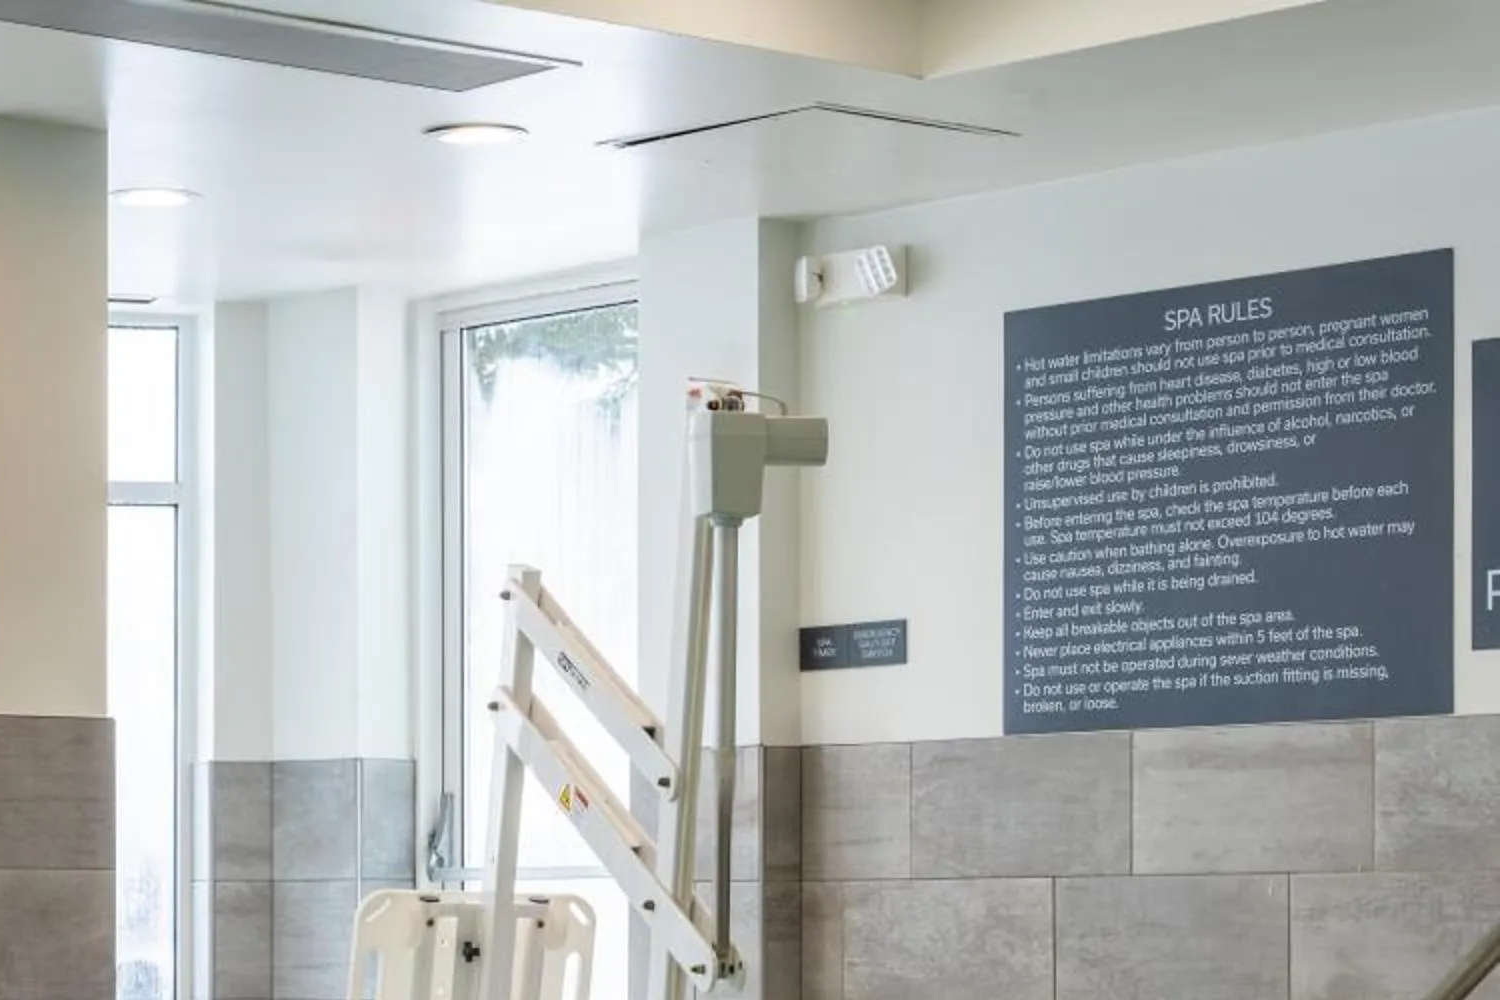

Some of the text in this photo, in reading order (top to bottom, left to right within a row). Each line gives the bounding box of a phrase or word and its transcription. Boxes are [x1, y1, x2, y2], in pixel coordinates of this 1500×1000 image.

[1164, 297, 1272, 330] SPA RULES
[1024, 357, 1044, 372] Hot
[1048, 354, 1079, 369] water
[1146, 343, 1170, 357] vary
[1175, 339, 1202, 352] from
[1253, 329, 1264, 342] to
[1380, 309, 1428, 326] women
[1024, 373, 1045, 388] and
[1048, 369, 1078, 385] small
[1175, 354, 1193, 369] not
[1197, 354, 1219, 366] use
[1223, 351, 1244, 365] spa
[1248, 345, 1275, 363] prior
[1280, 342, 1292, 356] to
[1129, 381, 1156, 394] from
[1159, 374, 1190, 391] heart
[1307, 356, 1333, 374] high
[1337, 357, 1349, 369] or
[1354, 353, 1375, 367] low
[1381, 346, 1418, 363] blood
[1076, 402, 1098, 417] and
[1101, 399, 1132, 414] other
[1281, 378, 1300, 393] not
[1305, 375, 1336, 390] enter
[1341, 371, 1360, 386] the
[1365, 370, 1389, 385] spa
[1226, 401, 1248, 417] and
[1325, 392, 1353, 405] from
[1359, 386, 1386, 402] their
[1024, 446, 1041, 459] Do
[1043, 443, 1062, 457] not
[1065, 443, 1086, 455] use
[1089, 440, 1110, 454] spa
[1113, 434, 1144, 449] while
[1147, 430, 1182, 446] under
[1186, 427, 1205, 441] the
[1267, 418, 1280, 432] of
[1401, 406, 1414, 417] or
[1024, 461, 1053, 475] other
[1057, 459, 1090, 473] drugs
[1093, 453, 1115, 468] that
[1119, 452, 1154, 465] cause
[1303, 434, 1316, 445] or
[1089, 469, 1123, 485] blood
[1107, 491, 1127, 503] use
[1131, 487, 1145, 503] by
[1199, 480, 1208, 493] is
[1115, 507, 1134, 521] the
[1204, 499, 1223, 512] the
[1227, 498, 1248, 513] spa
[1377, 480, 1408, 496] each
[1023, 552, 1045, 565] Use
[1095, 545, 1126, 559] when
[1307, 527, 1319, 541] to
[1323, 524, 1344, 539] hot
[1348, 522, 1382, 537] water
[1387, 521, 1415, 535] may
[1050, 531, 1072, 546] Spa
[1151, 519, 1180, 534] must
[1184, 517, 1204, 531] not
[1255, 510, 1278, 525] 104
[1023, 555, 1190, 582] cause and
[1023, 575, 1204, 601] Do not use spa while it is being
[1023, 606, 1053, 620] Enter
[1056, 603, 1078, 618] and
[1023, 626, 1052, 641] Keep
[1055, 624, 1068, 637] all
[1177, 614, 1197, 628] out
[1201, 613, 1212, 627] of
[1217, 612, 1235, 626] the
[1239, 613, 1261, 626] spa
[1023, 646, 1057, 658] Never
[1059, 643, 1090, 659] place
[1257, 630, 1264, 643] 5
[1269, 628, 1292, 642] feet
[1296, 626, 1308, 640] of
[1312, 625, 1332, 639] the
[1023, 665, 1044, 680] Spa
[1080, 660, 1099, 674] not
[1103, 660, 1118, 672] be
[1023, 684, 1040, 697] Do
[1043, 682, 1061, 695] not
[1065, 684, 1085, 694] use
[1088, 683, 1100, 693] or
[1152, 676, 1171, 689] the
[1175, 677, 1196, 691] spa
[1199, 673, 1206, 687] if
[1210, 672, 1230, 686] the
[1323, 666, 1332, 679] is
[1069, 700, 1080, 711] or
